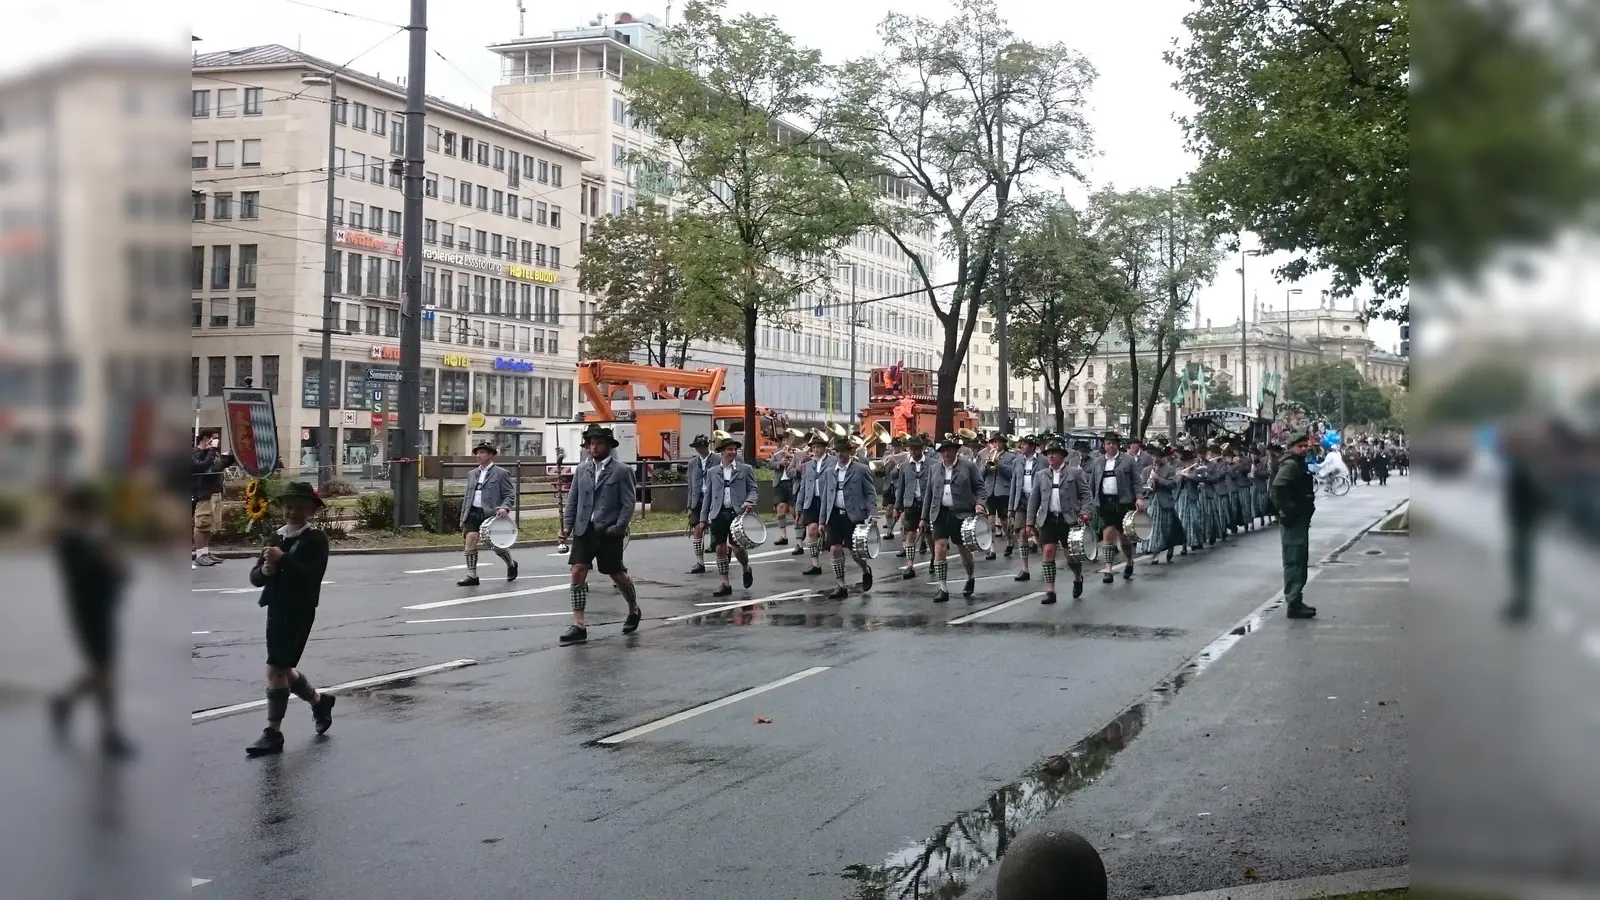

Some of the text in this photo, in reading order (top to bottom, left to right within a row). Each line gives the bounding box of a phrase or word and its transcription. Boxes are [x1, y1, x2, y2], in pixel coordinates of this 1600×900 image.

[421, 249, 464, 265] rapienetz
[374, 391, 382, 401] U
[374, 403, 382, 413] S
